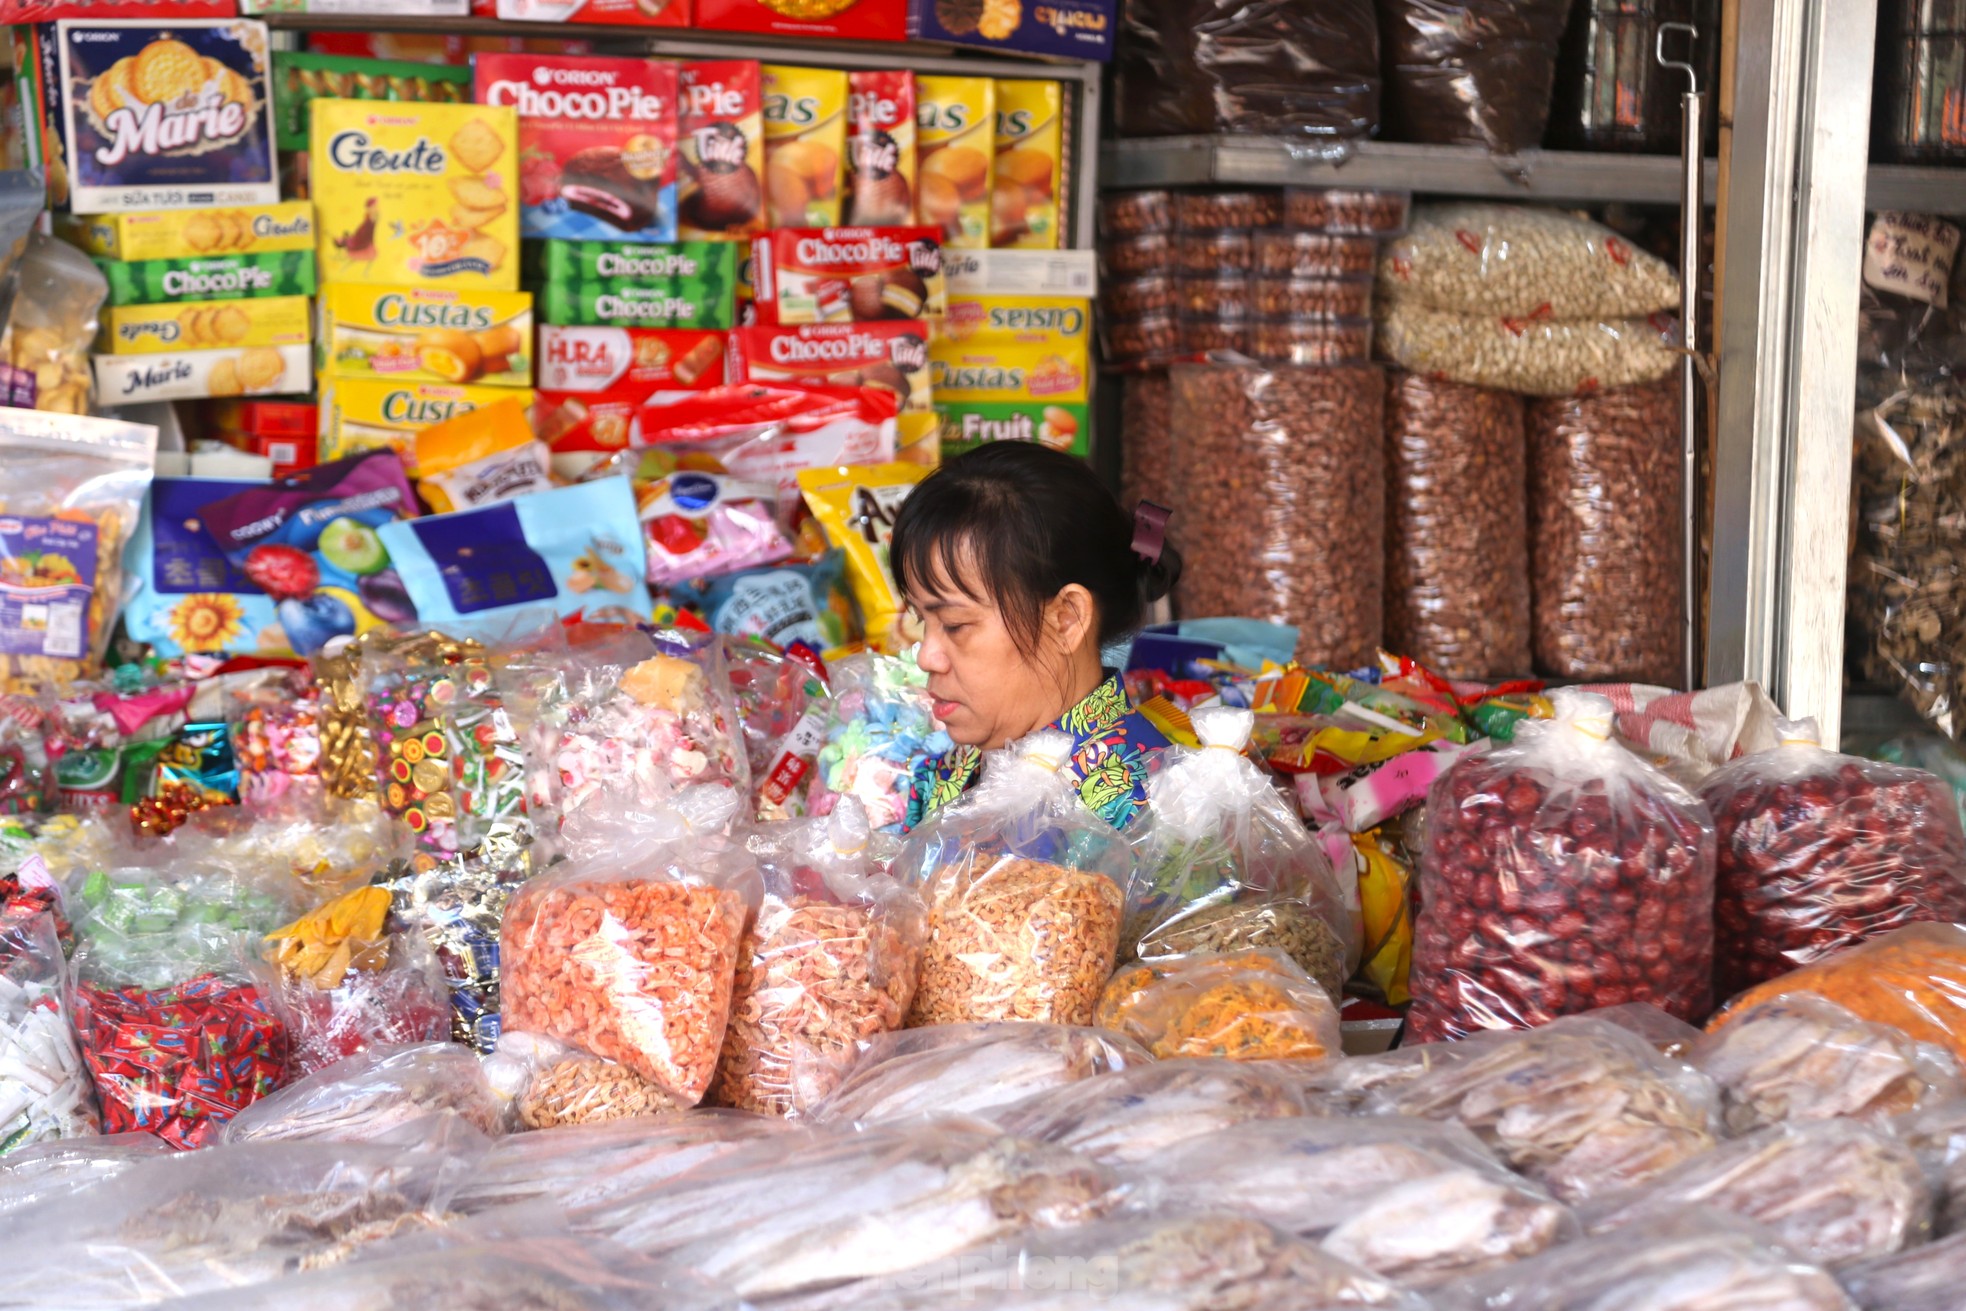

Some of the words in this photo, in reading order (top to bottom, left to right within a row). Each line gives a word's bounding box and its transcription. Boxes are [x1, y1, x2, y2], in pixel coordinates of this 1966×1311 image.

[553, 69, 616, 85] ORION
[96, 97, 246, 165] Marie
[941, 255, 979, 278] arie
[374, 294, 494, 329] Custas
[990, 307, 1084, 336] Custas
[122, 361, 192, 394] Marie
[962, 412, 1034, 440] Fruit
